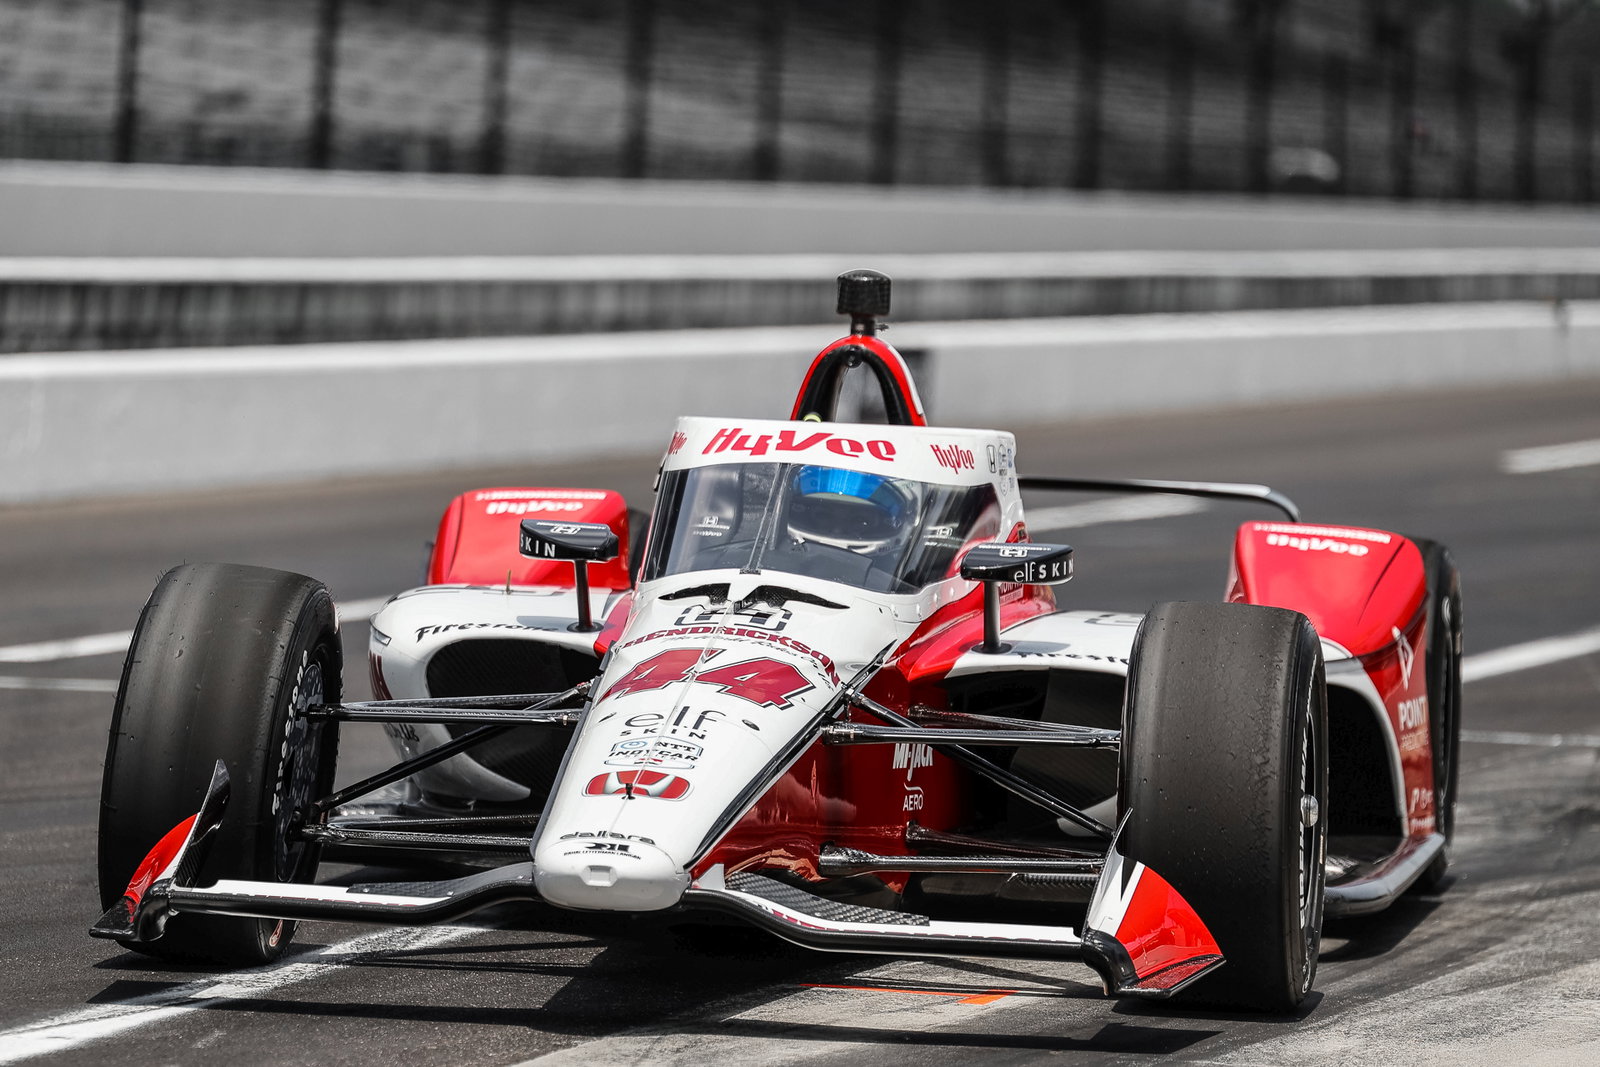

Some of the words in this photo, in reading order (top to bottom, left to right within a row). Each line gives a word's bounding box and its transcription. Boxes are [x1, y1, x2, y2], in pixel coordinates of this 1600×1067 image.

[702, 428, 896, 461] HyVee
[930, 444, 974, 475] HyVee
[520, 533, 556, 558] SKIN
[1014, 562, 1036, 582] elf
[1039, 559, 1074, 579] SKIN
[415, 623, 559, 643] Firestone
[622, 626, 840, 688] HENDRICKSON
[594, 647, 816, 711] 44
[625, 706, 726, 730] elf
[1398, 696, 1428, 731] POINT
[620, 728, 706, 740] SKIN
[655, 741, 696, 752] NTT
[903, 794, 924, 811] AERO
[560, 831, 656, 846] dallara
